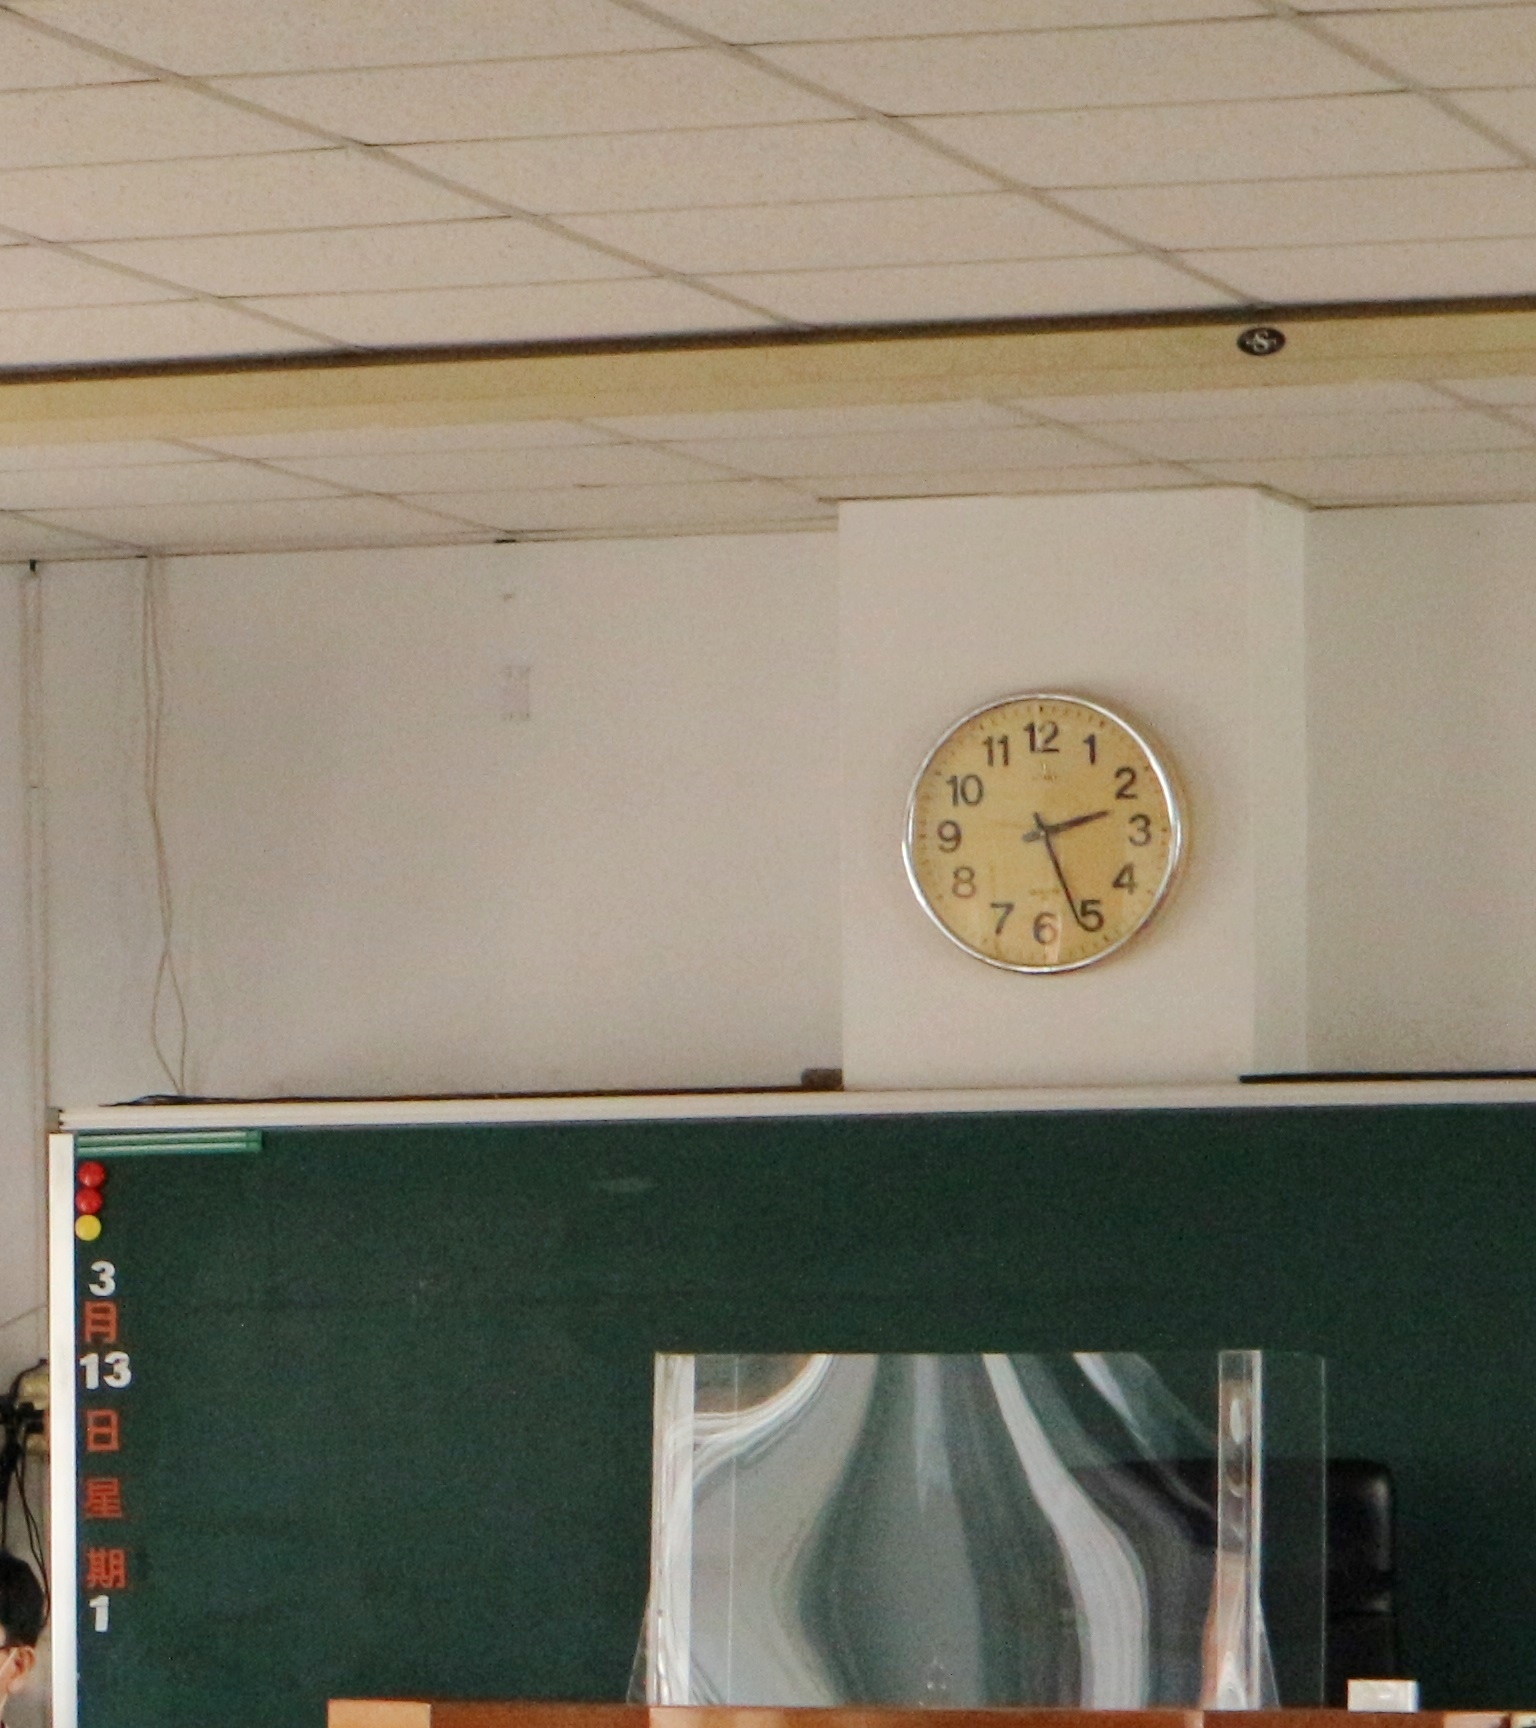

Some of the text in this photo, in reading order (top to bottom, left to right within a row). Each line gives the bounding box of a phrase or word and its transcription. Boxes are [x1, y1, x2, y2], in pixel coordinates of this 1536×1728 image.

[983, 734, 1009, 767] 11
[1024, 720, 1060, 753] 12
[1083, 734, 1097, 765] 1
[946, 774, 984, 807] 10
[1115, 767, 1138, 800] 2
[937, 820, 962, 853] 9
[1128, 814, 1151, 847] 3
[951, 866, 976, 900] 8
[1112, 863, 1137, 896] 4
[990, 902, 1015, 936] 7
[1033, 911, 1058, 945] 6
[1079, 899, 1104, 932] 5
